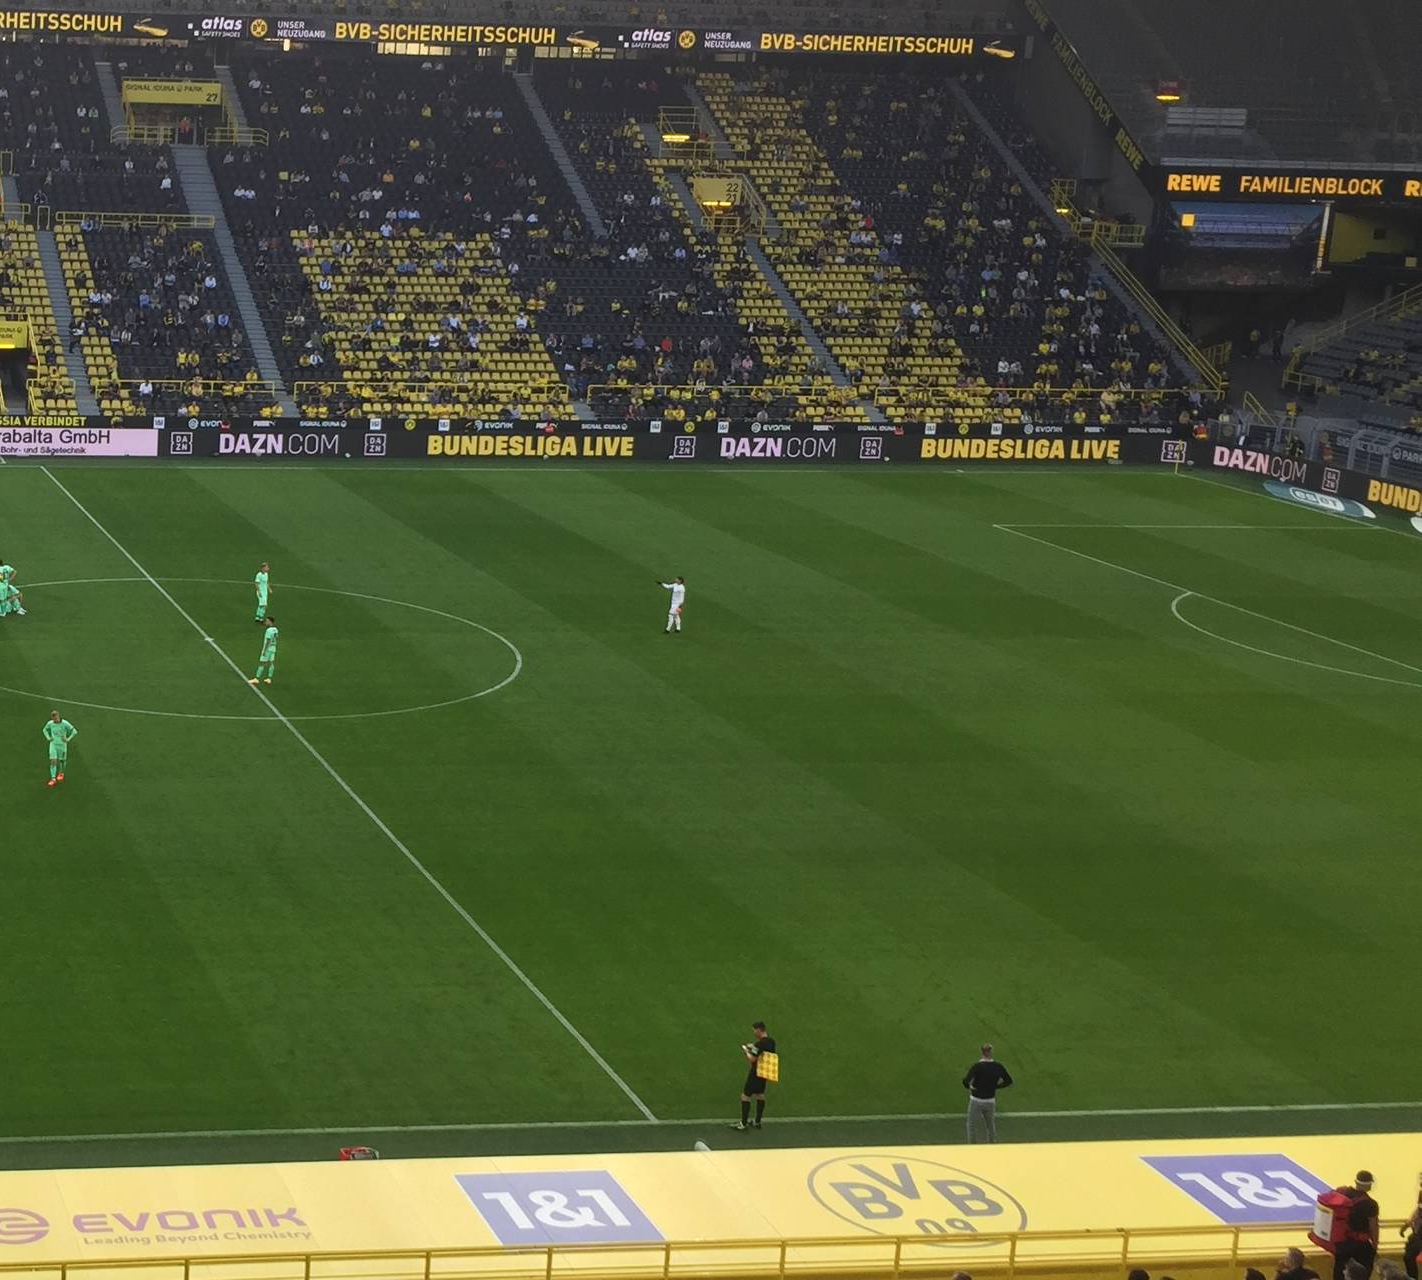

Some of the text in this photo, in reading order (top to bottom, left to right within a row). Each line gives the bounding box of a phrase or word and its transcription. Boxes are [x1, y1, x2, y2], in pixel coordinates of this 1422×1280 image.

[202, 17, 242, 30] atlas
[277, 21, 305, 29] UNSER
[277, 29, 326, 38] NEUZUGANG
[335, 22, 556, 44] BVB-SICHERHEITSSCHUH
[631, 29, 671, 42] atlas
[706, 32, 732, 40] UNSER
[704, 40, 751, 49] NEUZUGANG
[760, 33, 974, 55] BVB-SICHERHEITSSCHUH
[206, 93, 218, 102] 27
[1115, 128, 1144, 170] REWE
[726, 183, 739, 192] 22
[1167, 174, 1221, 192] REWE
[1240, 175, 1384, 196] FAMILIENBLOCK
[726, 193, 737, 202] 21
[24, 416, 86, 427] VERBINDET
[59, 430, 110, 444] GmbH
[174, 434, 187, 442] DA
[219, 433, 338, 454] DAZN.COM
[369, 435, 381, 443] DA
[1, 446, 22, 454] Bohr-
[40, 446, 86, 455] Sägetechnik
[175, 442, 187, 451] ZN
[369, 443, 381, 451] ZN
[427, 435, 634, 457] BUNDESLIGA LIVE
[720, 437, 836, 458] DAZN.COM
[921, 438, 1120, 460] BUNDESLIGA LIVE
[1213, 446, 1307, 483] DAZN.COM
[1368, 479, 1422, 513] BUND
[829, 1163, 1004, 1219] BVB
[1175, 1170, 1318, 1209] 1&1
[482, 1189, 631, 1230] 1&1
[72, 1207, 308, 1233] EVONIK
[83, 1228, 312, 1248] Leading Beyond Chemistry
